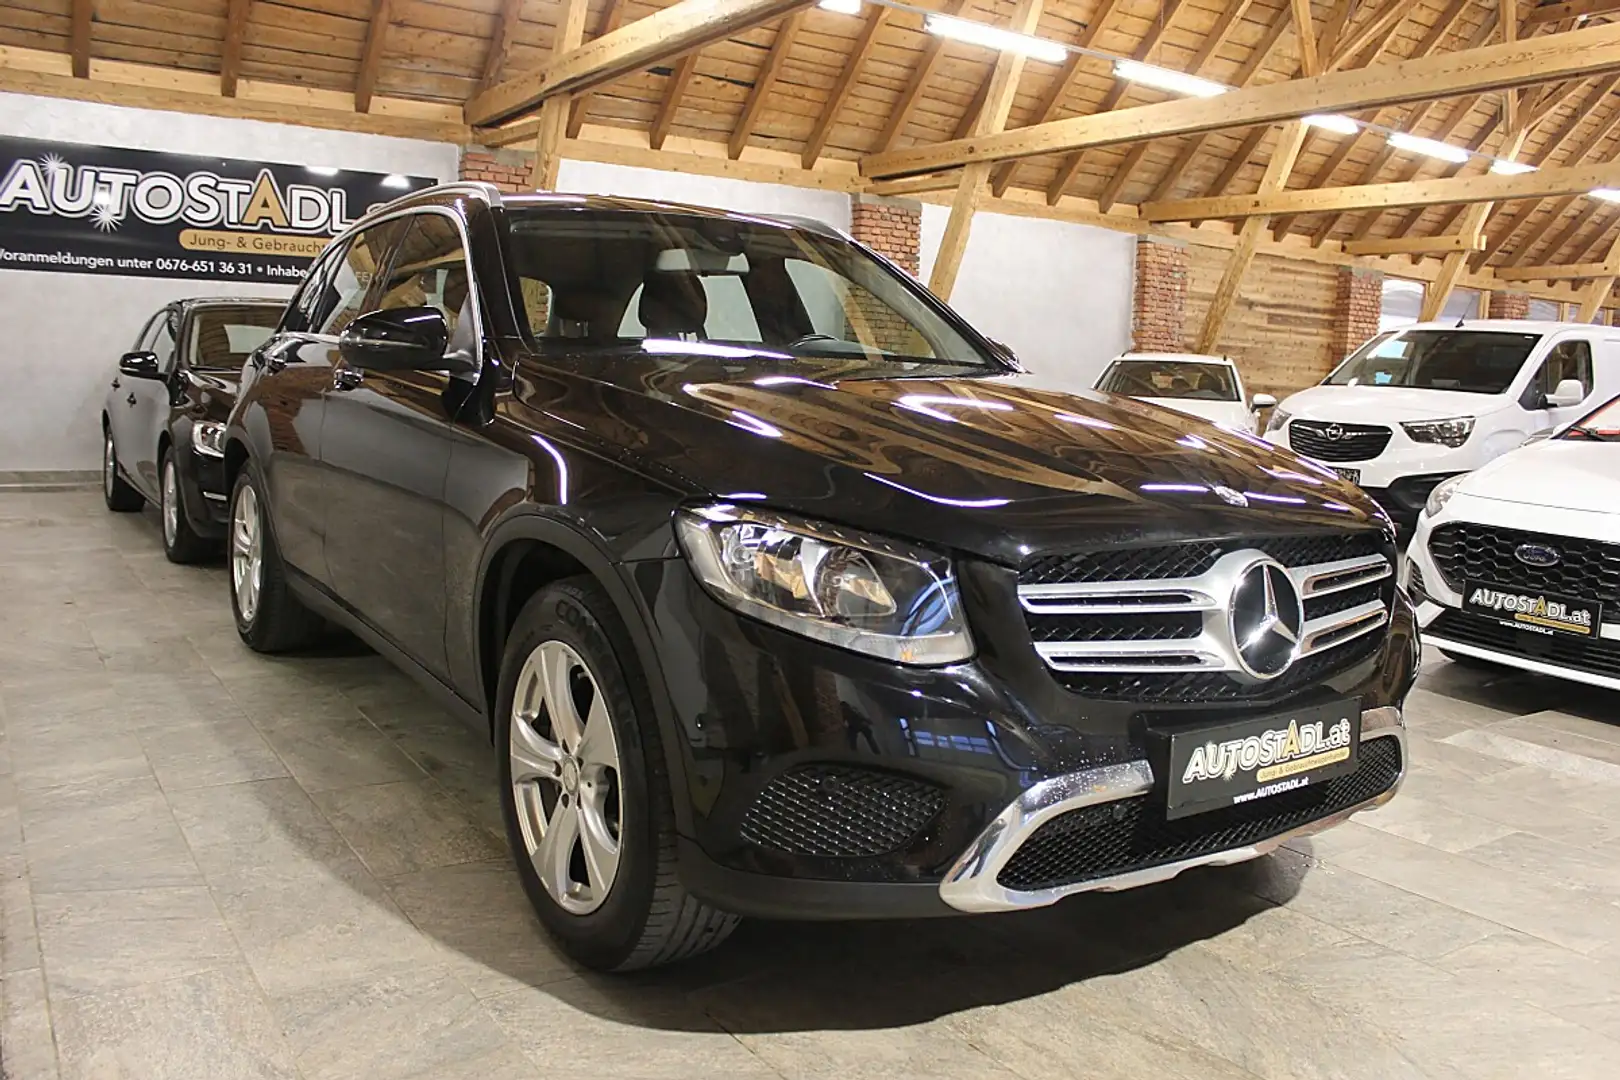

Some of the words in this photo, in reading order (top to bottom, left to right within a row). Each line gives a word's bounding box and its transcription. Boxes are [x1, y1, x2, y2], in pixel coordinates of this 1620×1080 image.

[189, 233, 231, 250] Jung-
[236, 236, 248, 249] &
[118, 257, 153, 269] unter
[156, 258, 215, 272] 0676-651
[218, 261, 235, 274] 36
[237, 263, 253, 275] 31
[1469, 587, 1591, 626] AUTOSTADL.at
[1182, 718, 1350, 784] AUTOSTADL.at
[1233, 776, 1309, 804] www.AUTOSTADL.at
